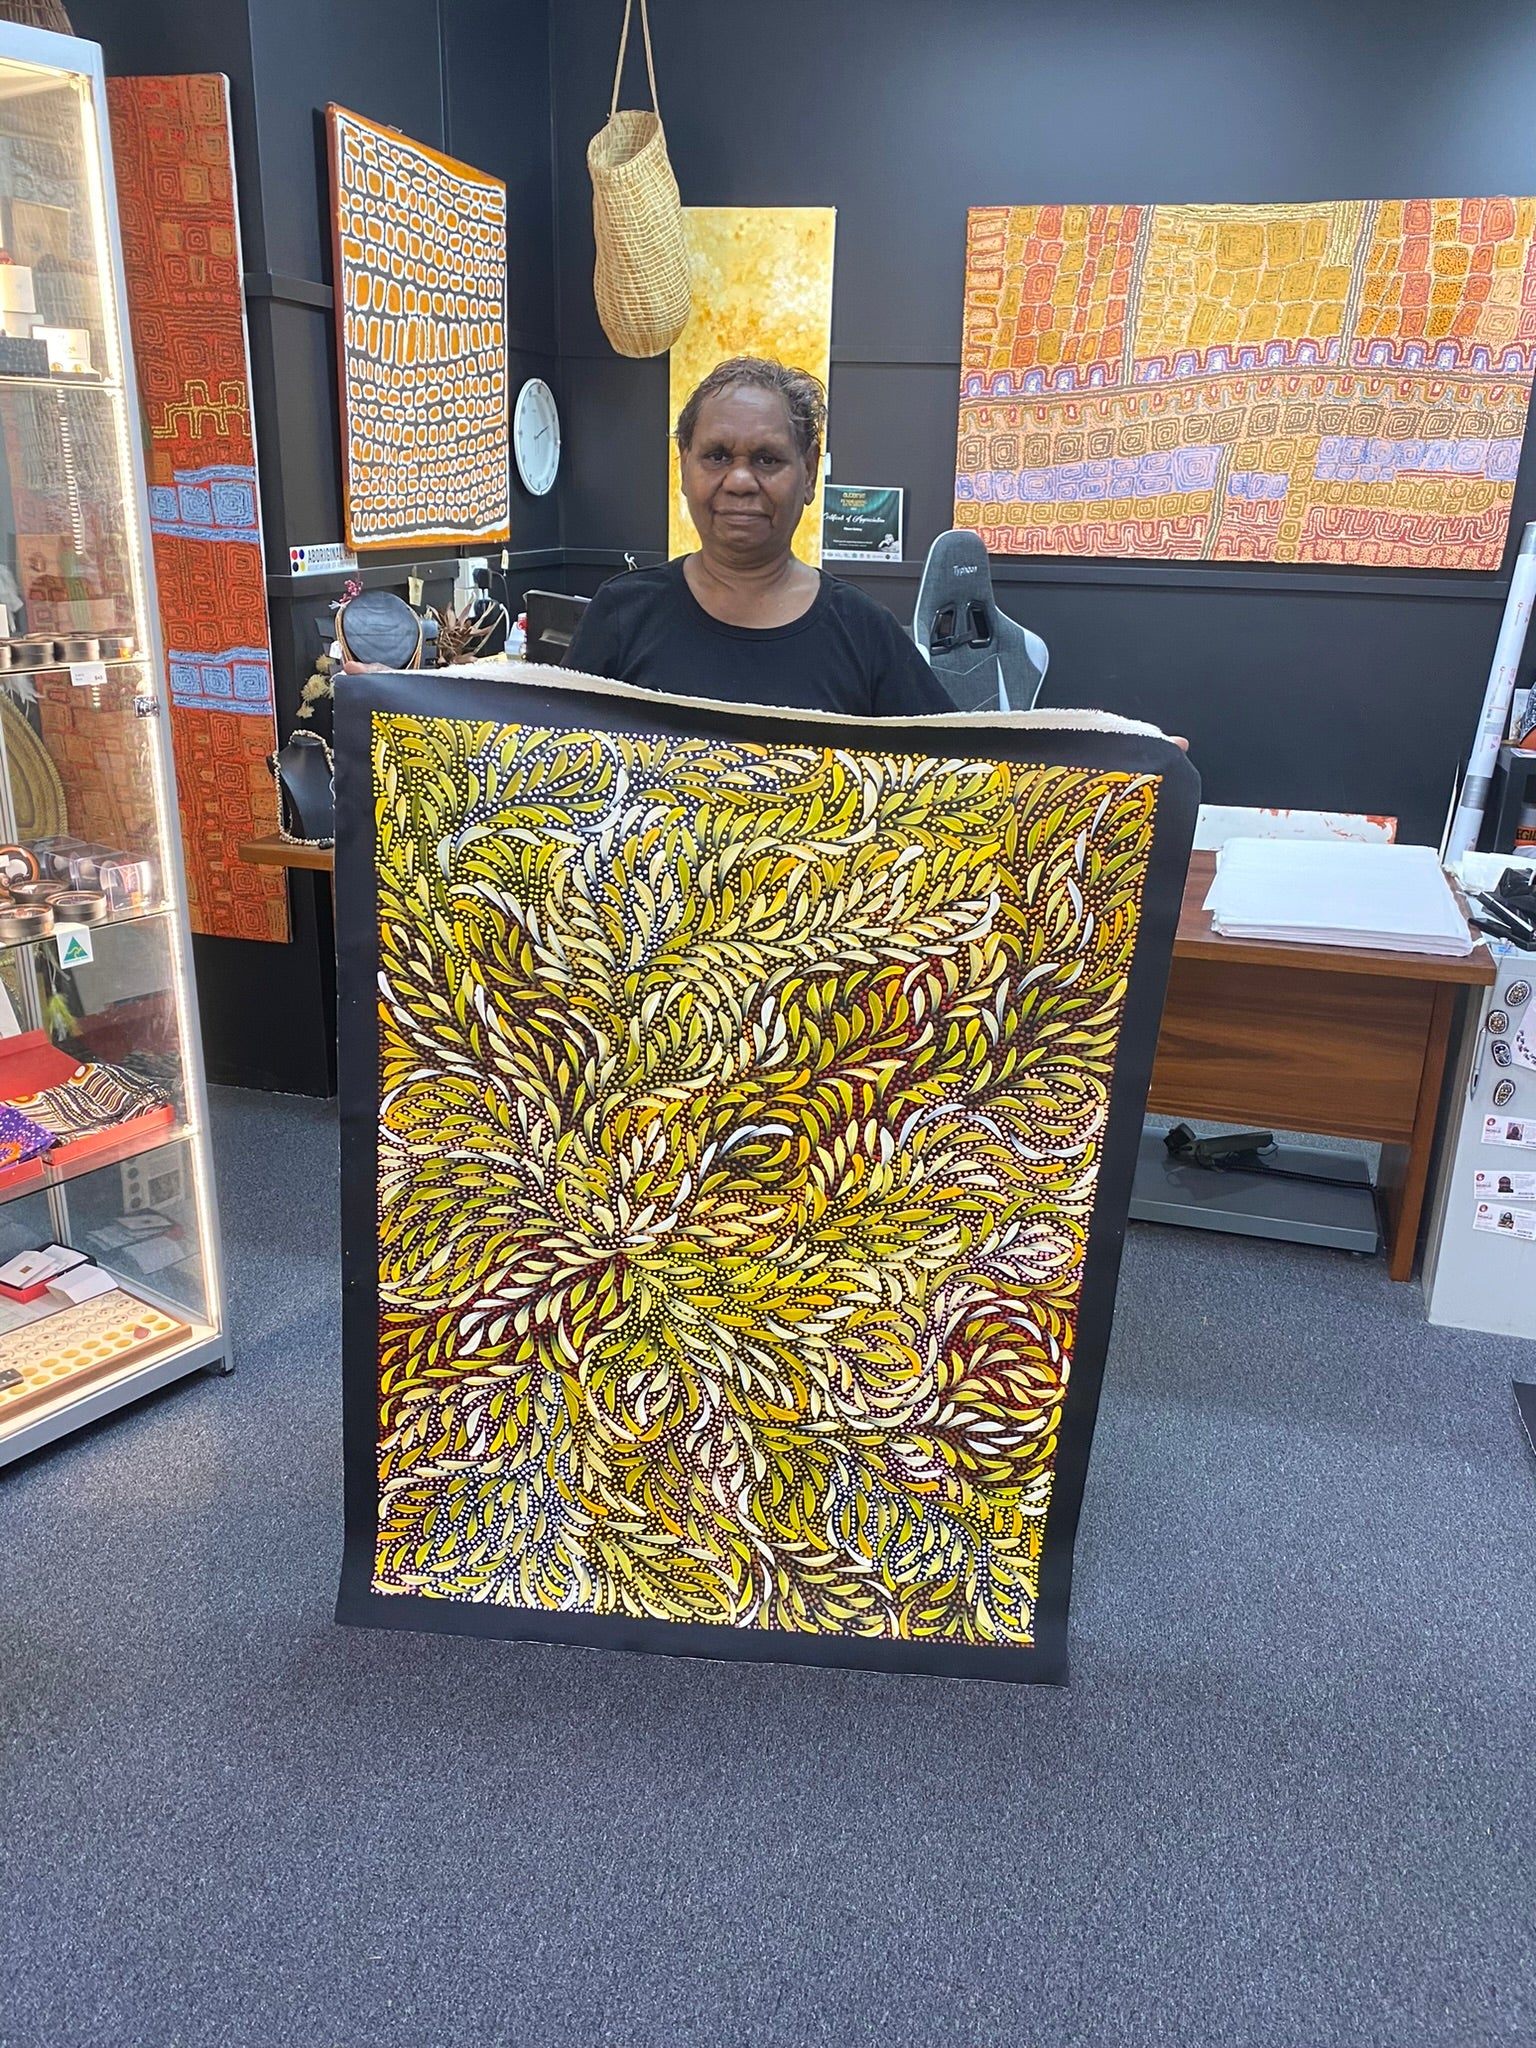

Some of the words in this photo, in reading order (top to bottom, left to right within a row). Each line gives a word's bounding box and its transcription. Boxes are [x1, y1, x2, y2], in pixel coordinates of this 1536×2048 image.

[846, 515, 852, 523] of
[852, 514, 886, 524] Appreciation
[308, 547, 344, 563] ABORIGINAL
